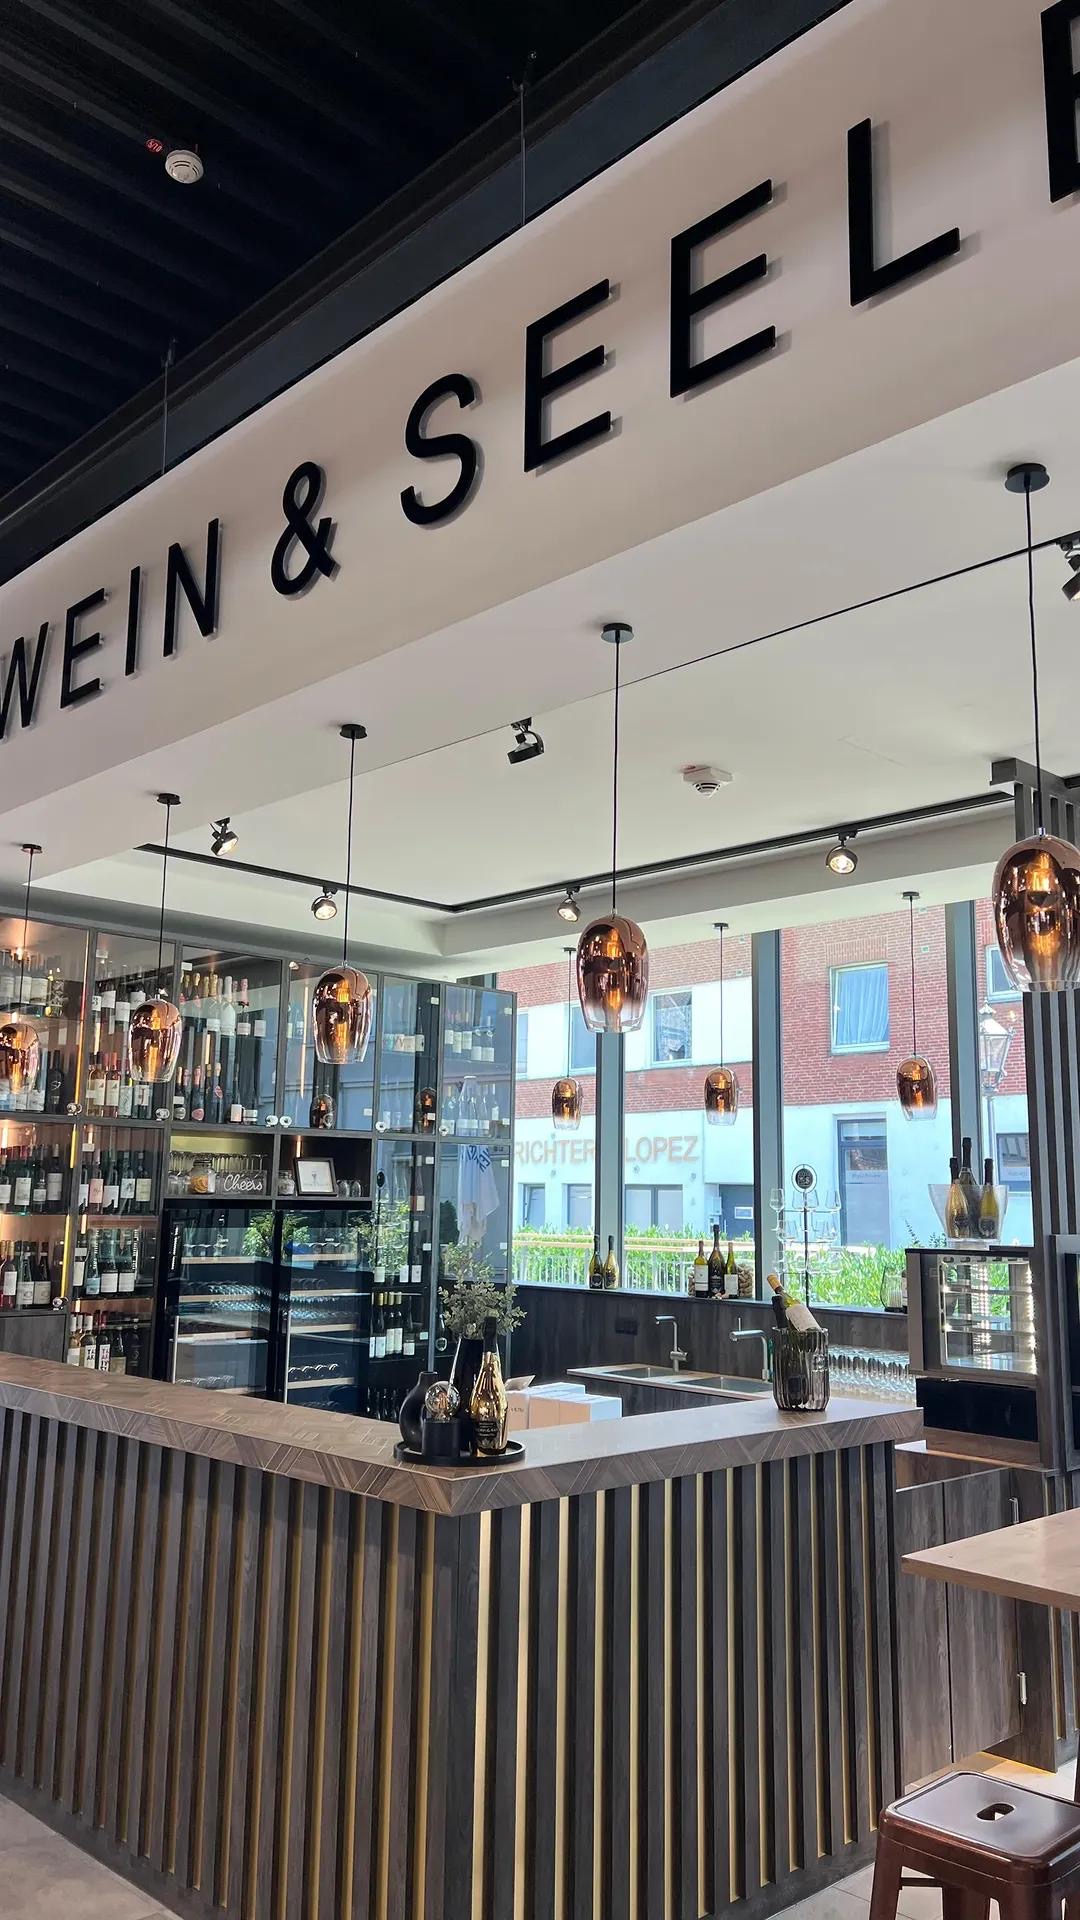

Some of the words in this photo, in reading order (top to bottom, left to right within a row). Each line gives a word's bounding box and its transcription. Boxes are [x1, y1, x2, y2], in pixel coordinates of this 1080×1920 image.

[0, 518, 220, 740] WEIN
[271, 461, 334, 596] &
[514, 1139, 595, 1164] RICHTER
[625, 1136, 699, 1162] LOPEZ
[223, 1174, 263, 1191] Cheers
